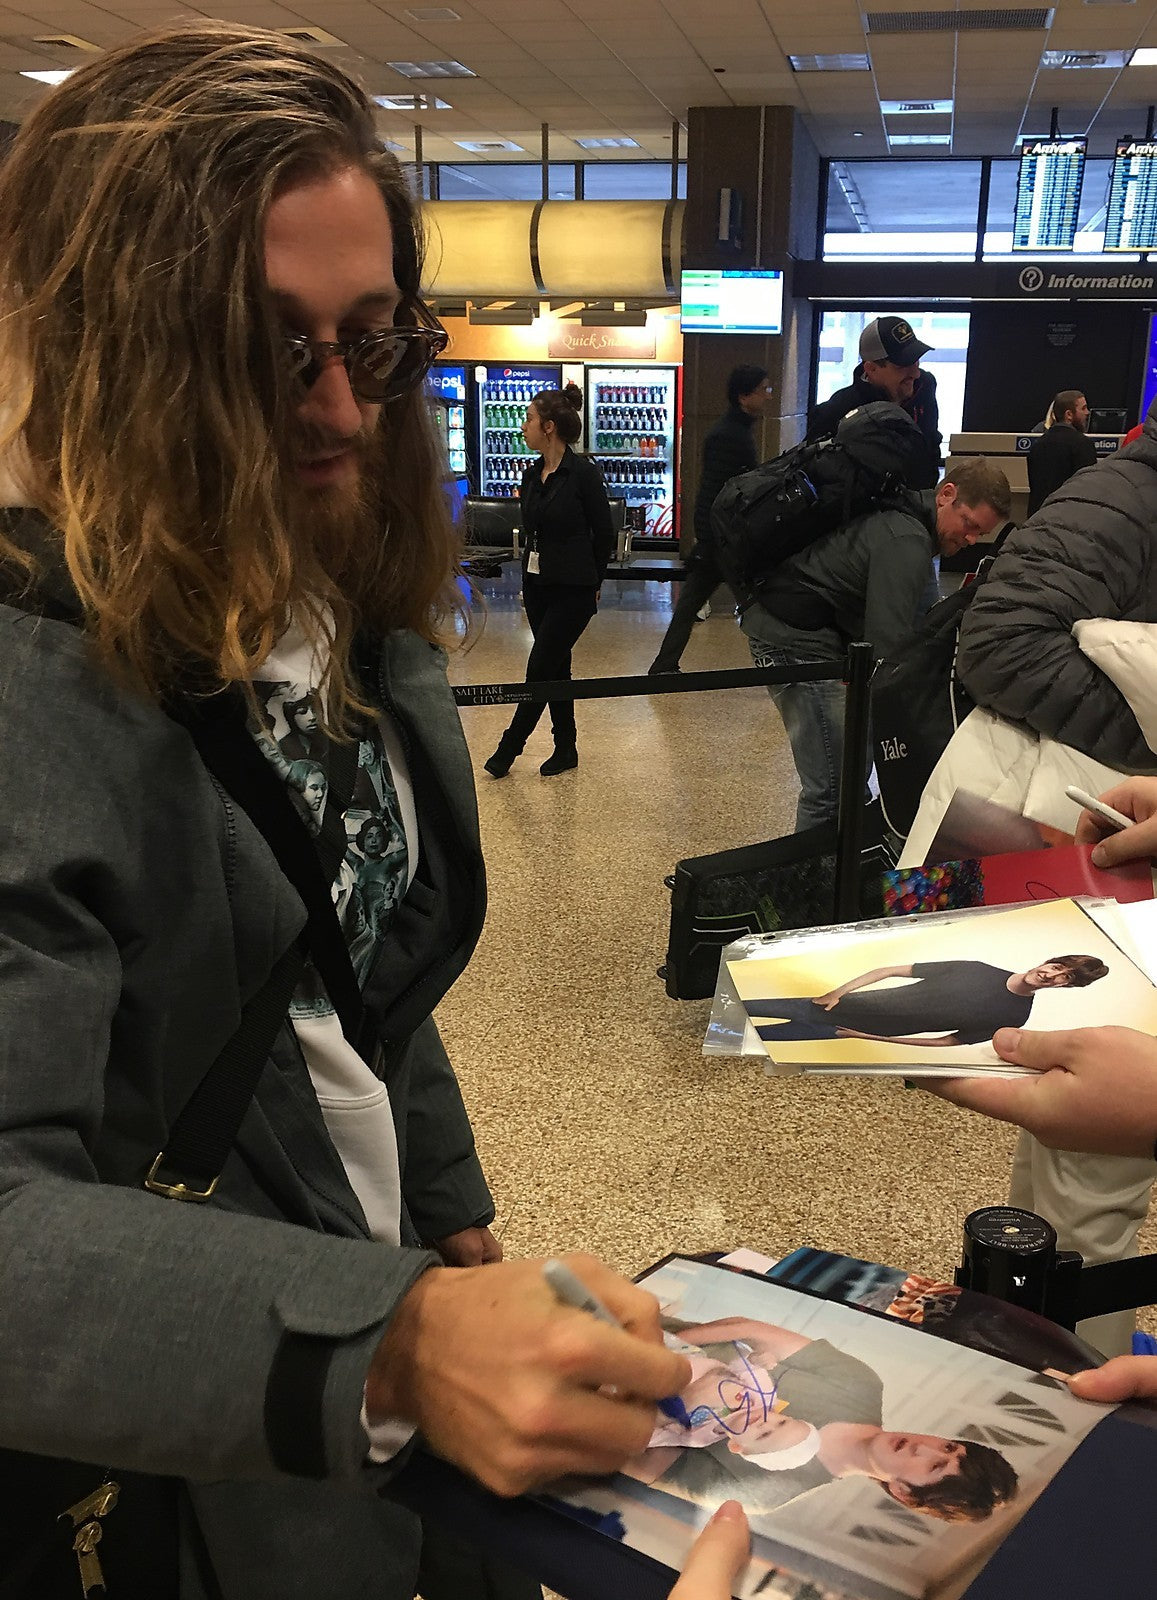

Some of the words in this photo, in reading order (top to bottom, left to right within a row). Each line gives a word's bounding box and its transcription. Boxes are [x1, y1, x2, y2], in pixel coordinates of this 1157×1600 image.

[1048, 274, 1154, 288] Information
[563, 333, 600, 350] Quick
[512, 370, 530, 378] pepsi
[1094, 440, 1117, 449] ation
[456, 687, 476, 696] SALT
[480, 686, 503, 695] LAKE
[473, 695, 496, 704] CITY
[881, 737, 908, 761] Yale
